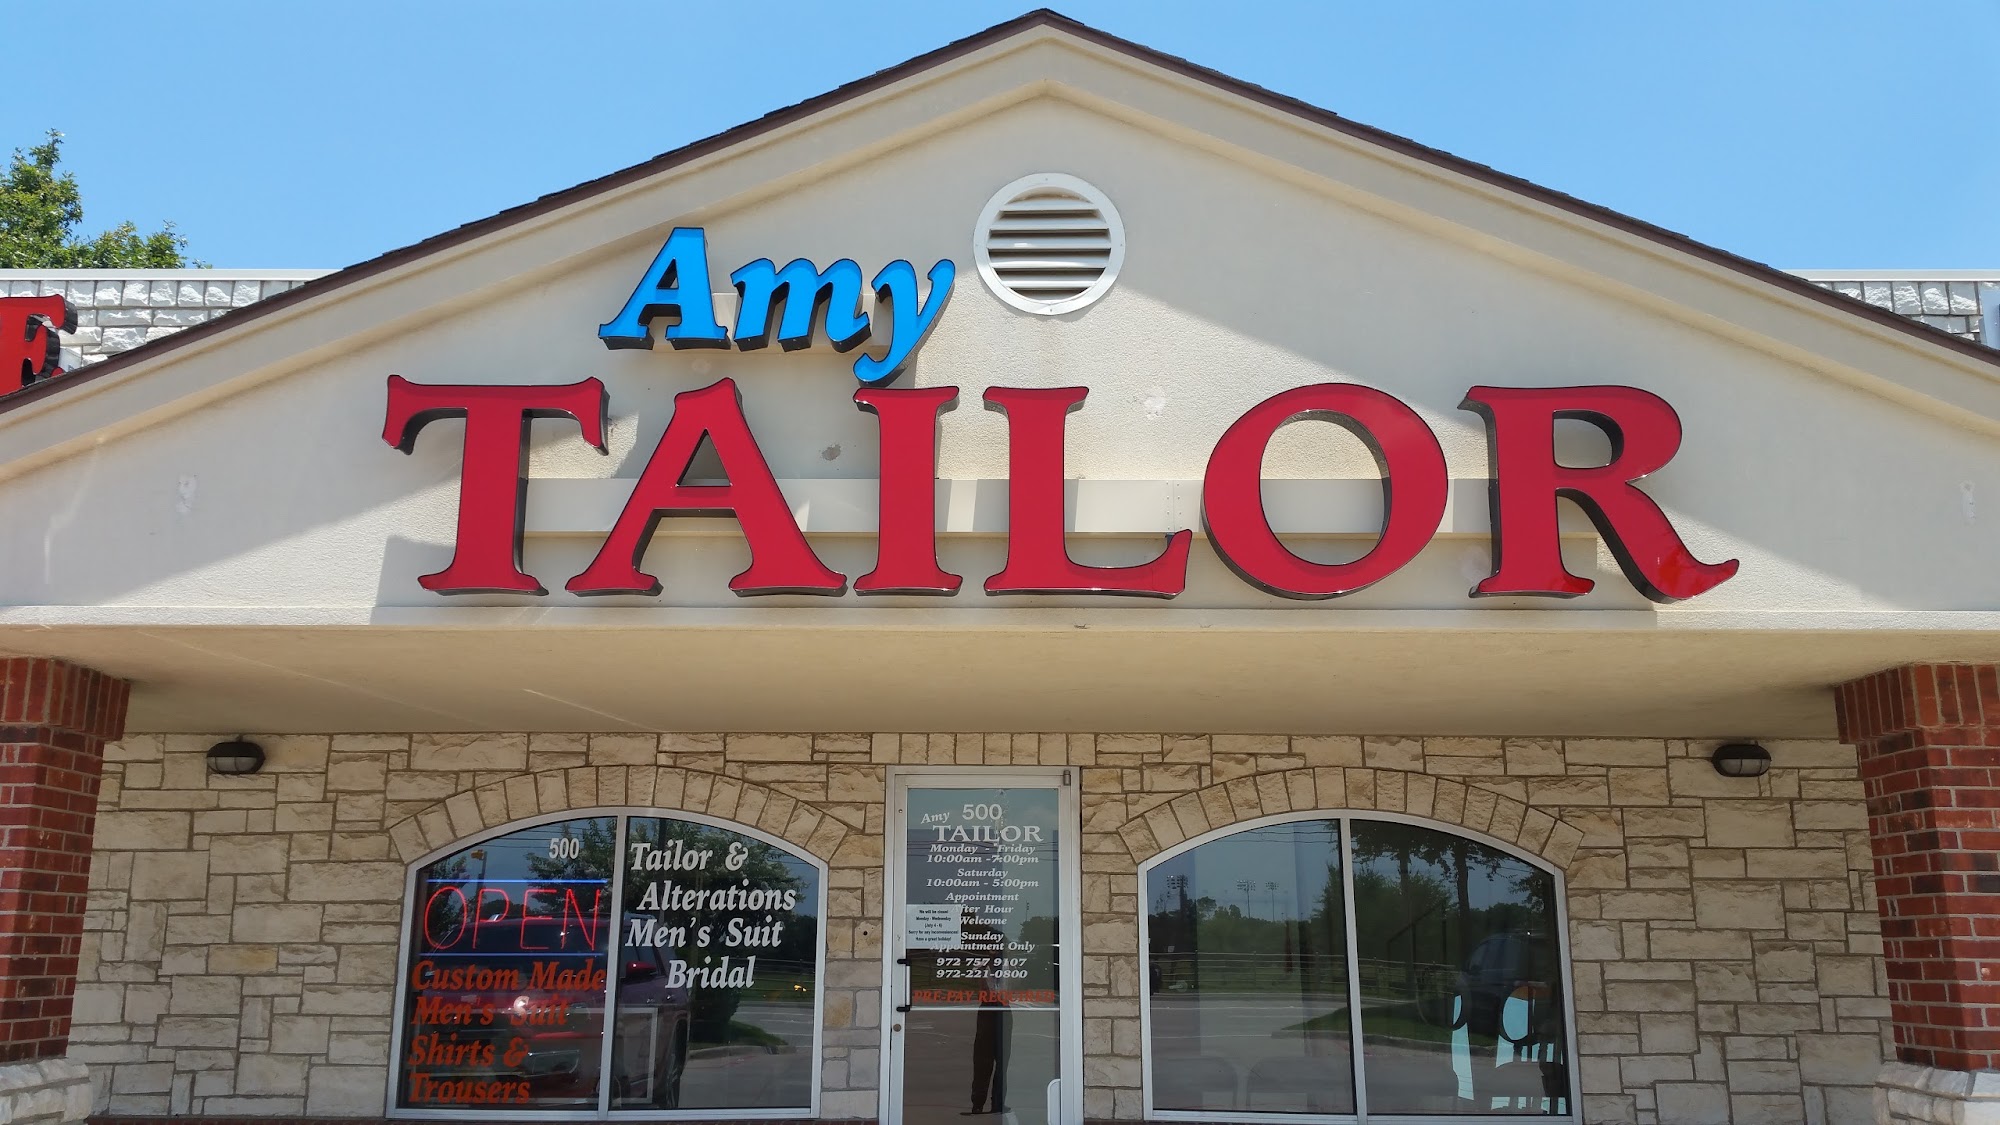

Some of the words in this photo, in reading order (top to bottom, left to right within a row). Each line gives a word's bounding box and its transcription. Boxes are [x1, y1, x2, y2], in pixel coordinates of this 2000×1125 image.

[598, 227, 956, 386] Amy
[382, 375, 1739, 602] TAILOR
[920, 811, 950, 824] Amy
[962, 803, 1003, 821] 500
[932, 825, 1044, 842] TAILOR
[549, 837, 580, 860] 500
[630, 839, 713, 871] Tailor
[725, 841, 749, 871] &
[930, 844, 978, 854] Monday
[997, 844, 1036, 855] Friday
[927, 854, 982, 863] 10:00am
[957, 868, 1009, 879] Saturday
[926, 879, 980, 888] 10:00am
[992, 879, 1039, 890] 5:00pm
[636, 878, 796, 911] Alterations
[945, 892, 1020, 904] Appointment
[985, 904, 1014, 914] Hour
[424, 885, 602, 951] OPEN
[959, 916, 1007, 926] Welcome
[625, 917, 711, 948] Men's
[725, 915, 783, 947] Suit
[960, 931, 1003, 942] Sunday
[930, 941, 1004, 953] Appointment
[1008, 941, 1035, 953] Only
[936, 957, 961, 967] 972
[965, 957, 990, 967] 757
[993, 957, 1027, 967] 9107
[412, 960, 520, 991] Custom
[527, 959, 606, 992] Made
[665, 955, 756, 989] Bridal
[936, 969, 1028, 979] 972-221-0800
[913, 989, 976, 1003] PRE-PAY
[977, 989, 1055, 1006] REQUIRED
[509, 994, 570, 1026] Suit
[408, 1032, 496, 1067] Shirts
[503, 1037, 530, 1067] &
[408, 1072, 531, 1104] Trousers
